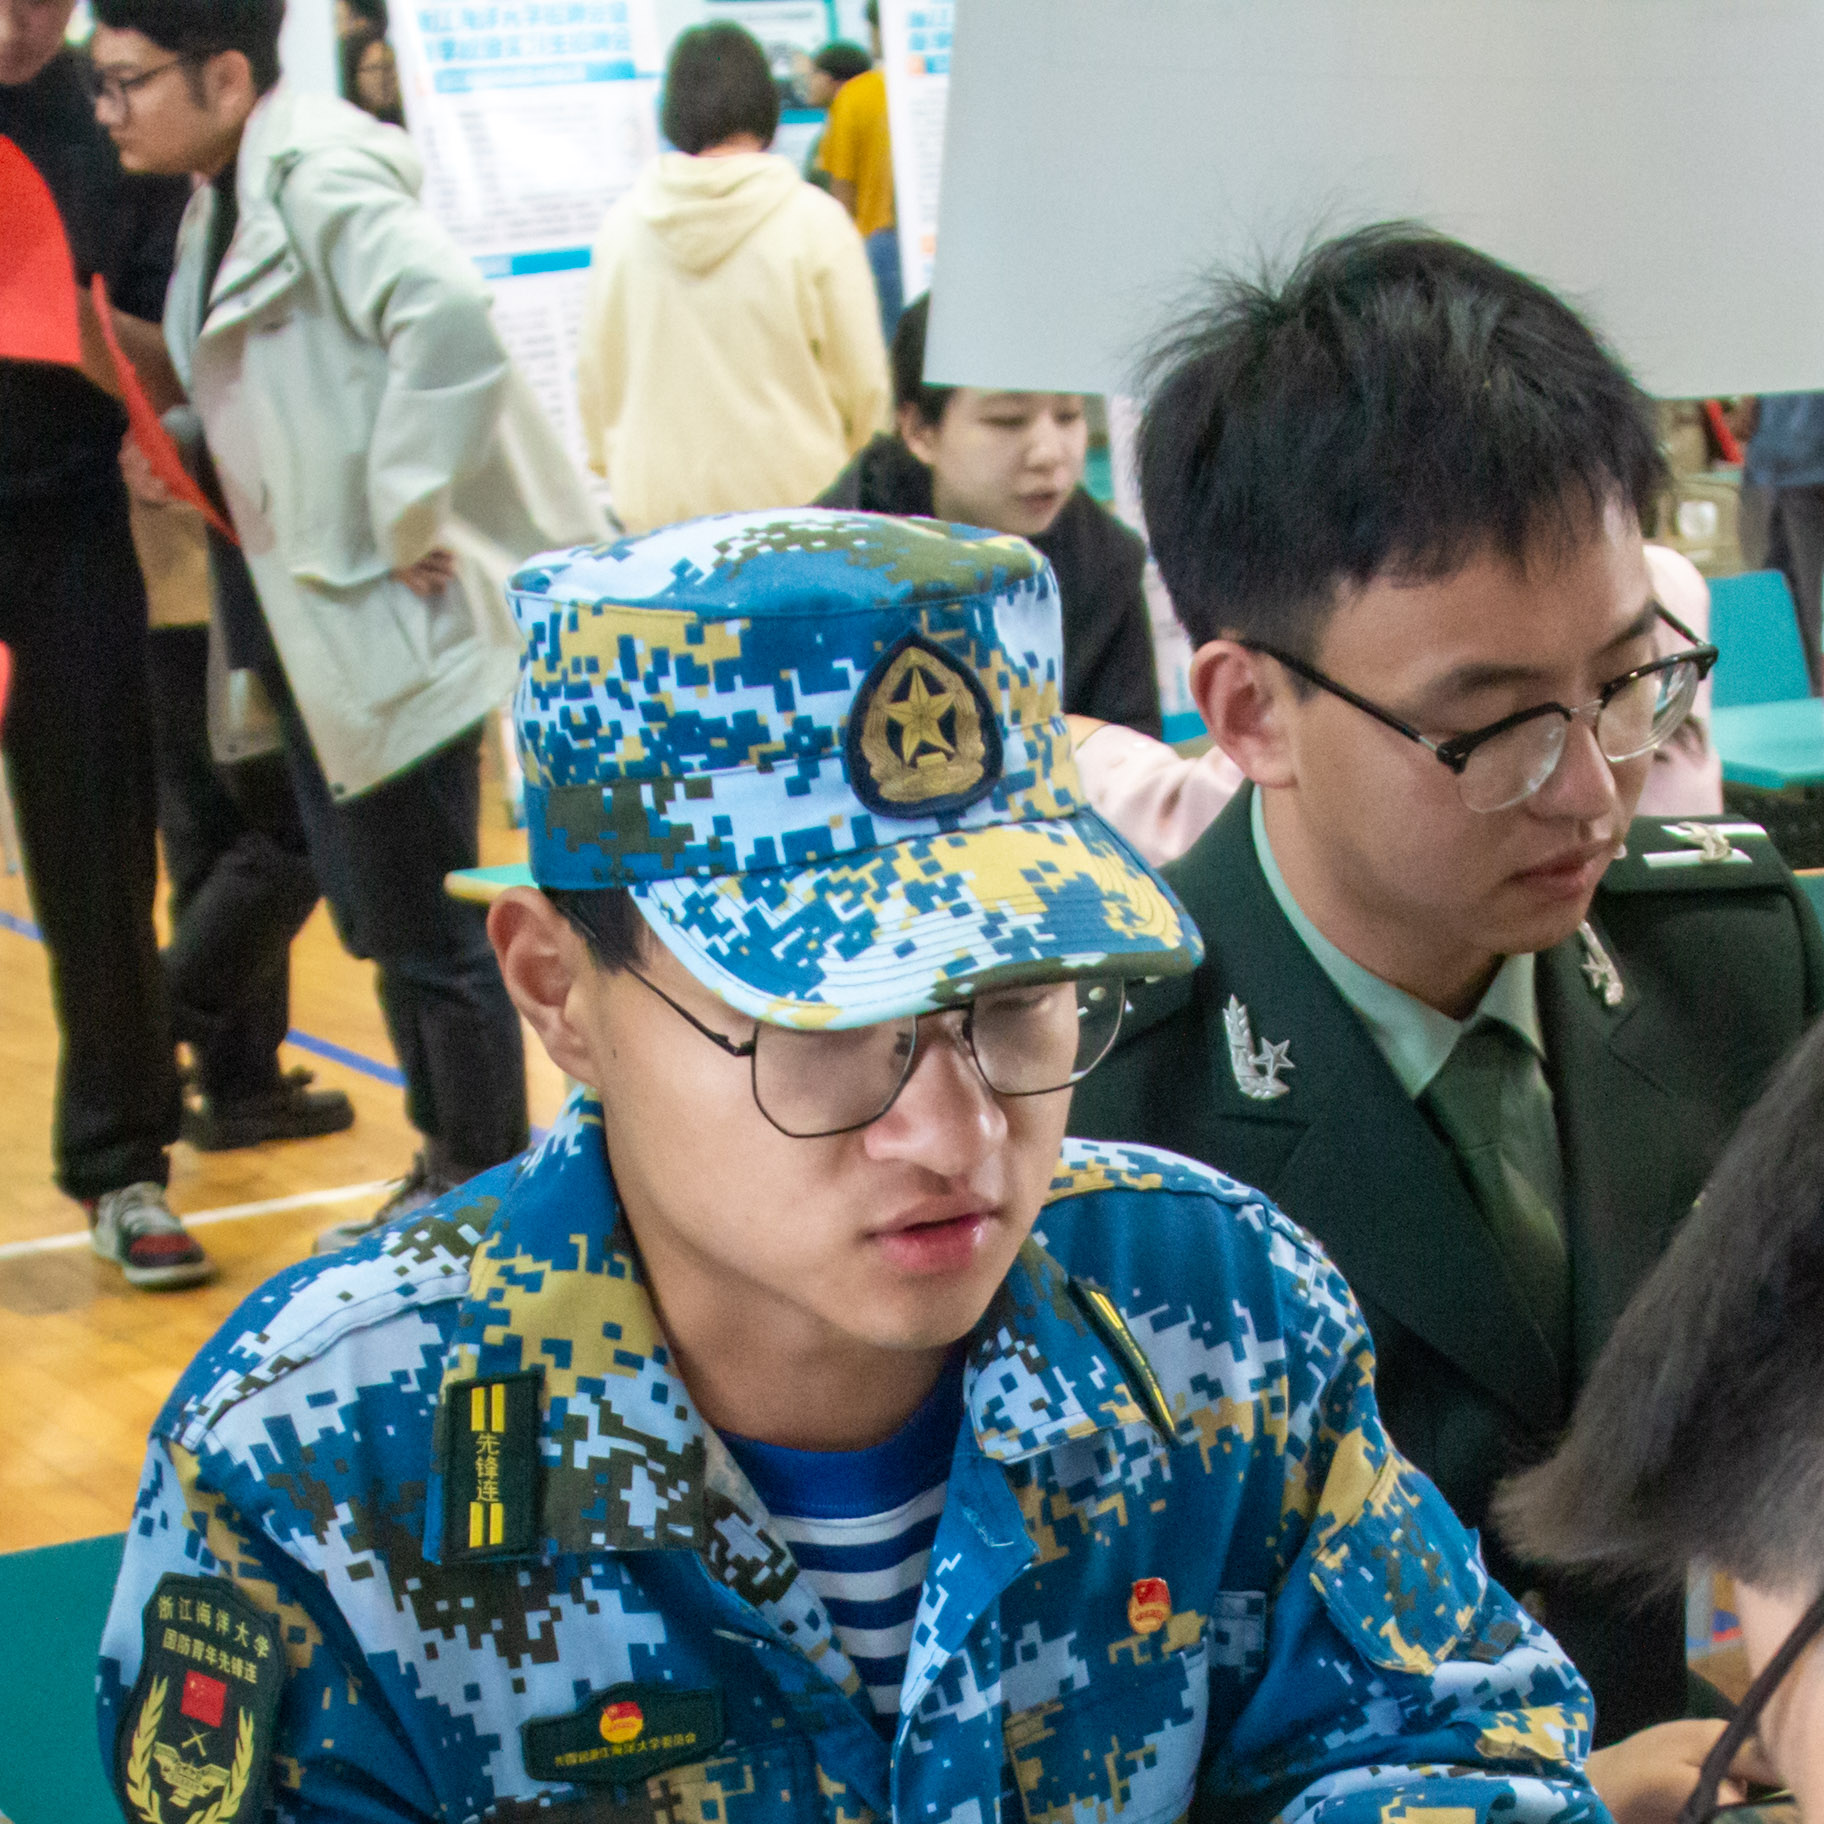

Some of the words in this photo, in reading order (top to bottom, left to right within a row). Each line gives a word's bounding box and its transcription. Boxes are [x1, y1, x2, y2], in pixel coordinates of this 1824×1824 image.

[475, 1432, 501, 1502] 先锋连
[158, 1595, 270, 1659] 浙江海洋大学
[162, 1627, 258, 1685] 国防青年先锋连
